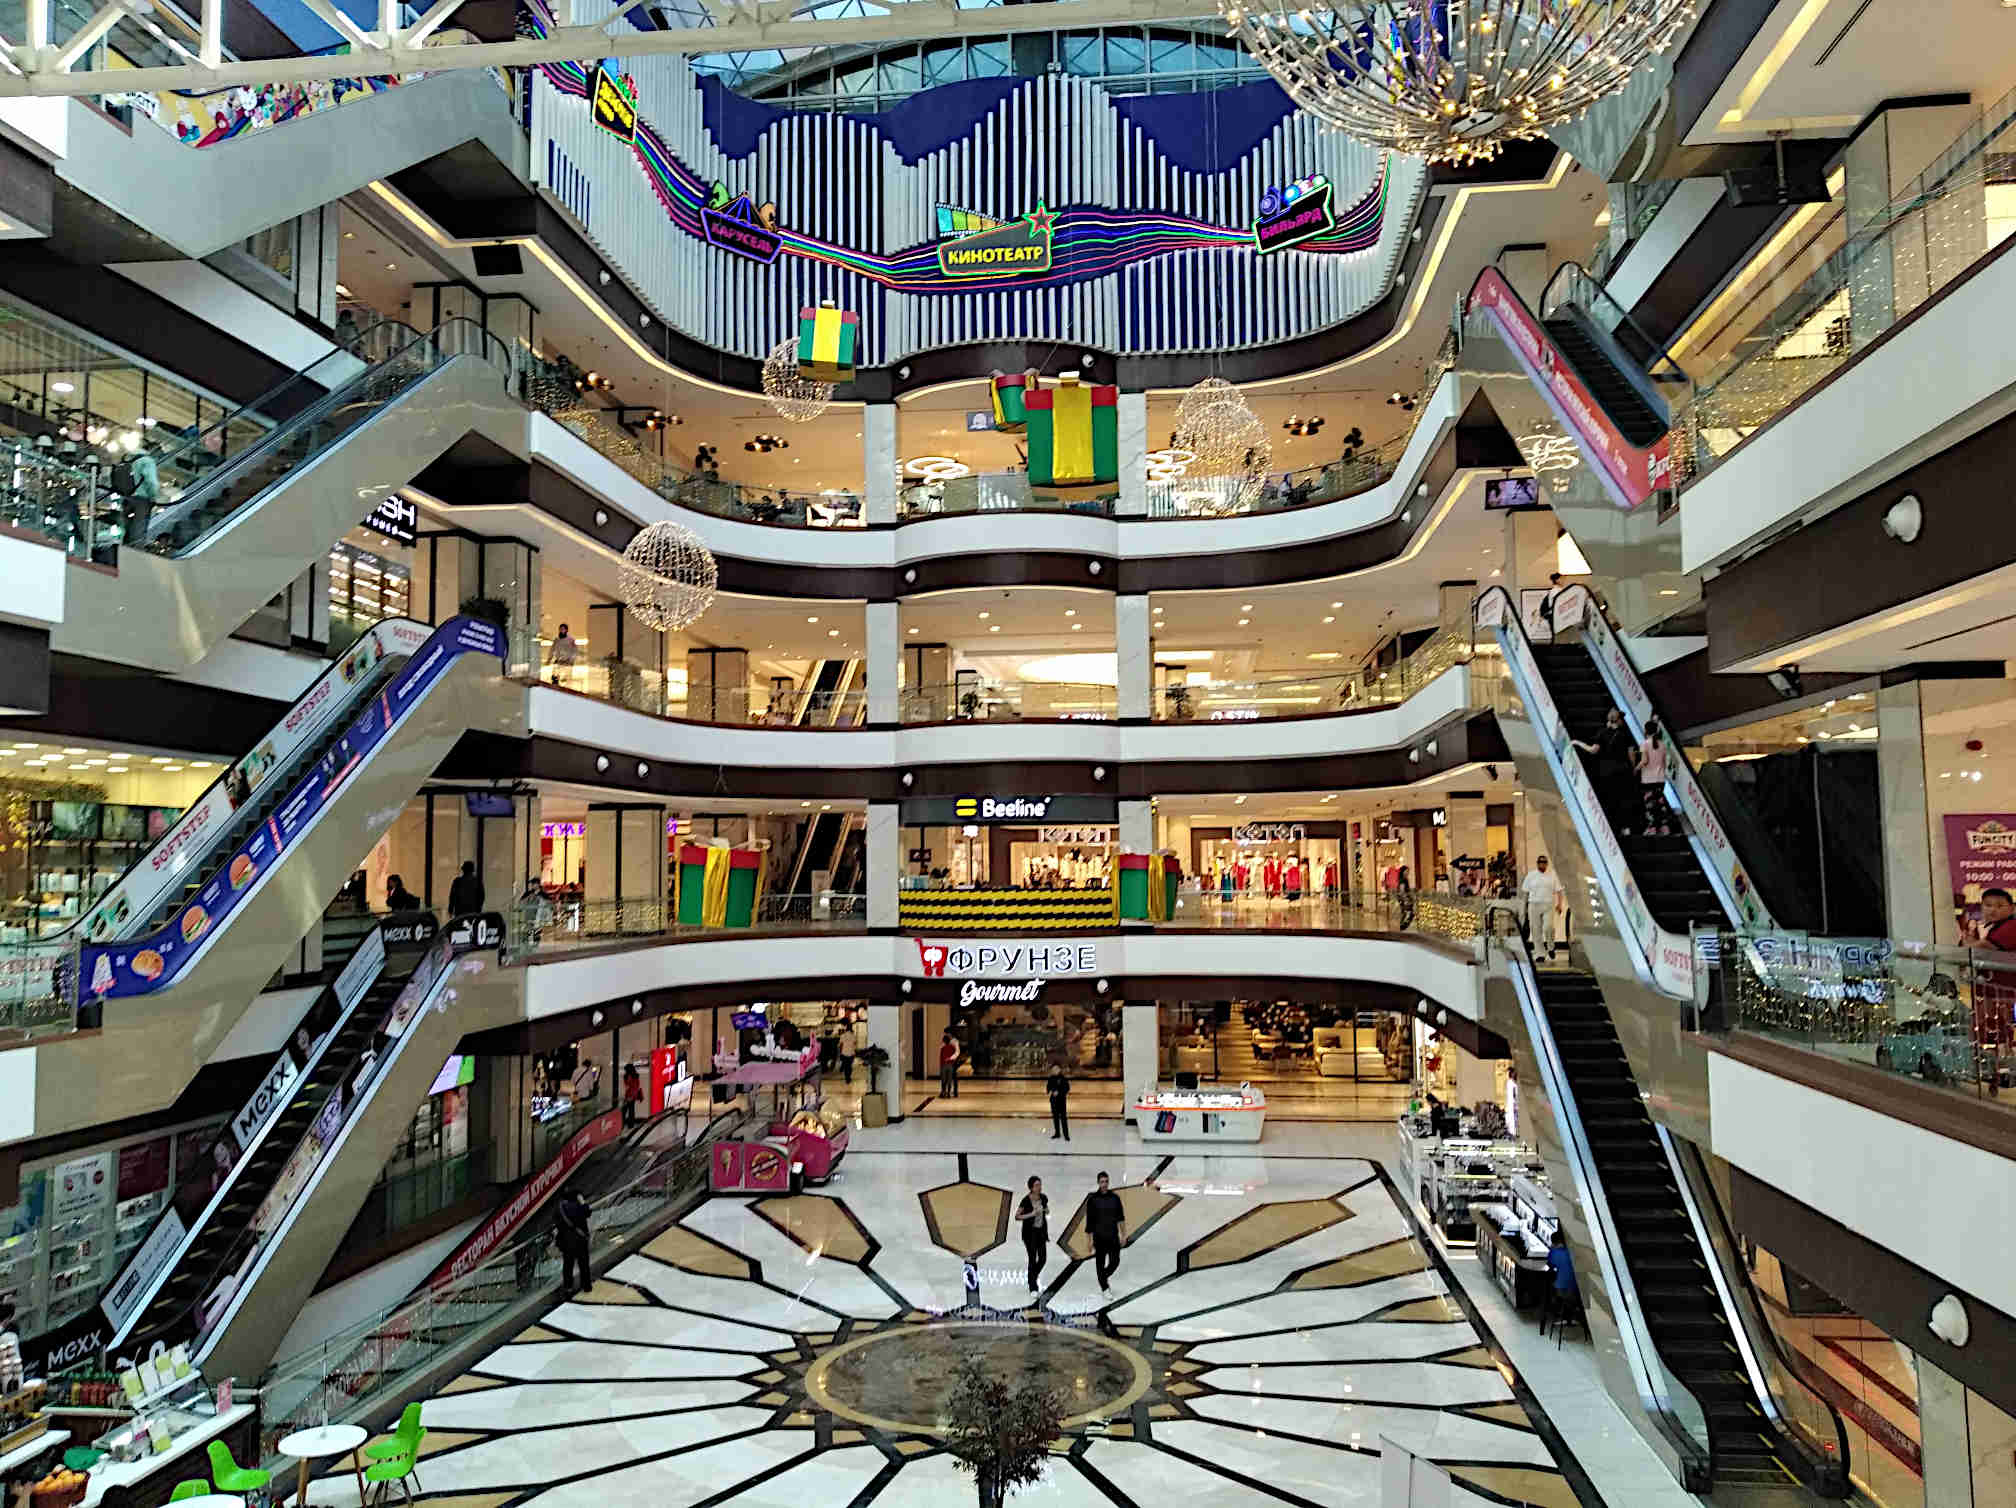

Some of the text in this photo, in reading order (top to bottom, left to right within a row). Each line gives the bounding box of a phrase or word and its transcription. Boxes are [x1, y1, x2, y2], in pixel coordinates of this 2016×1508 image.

[948, 246, 1044, 265] КИНОТЕАТР
[982, 798, 1046, 818] Beeline
[151, 804, 210, 872] SOFTSTEP
[949, 945, 1097, 974] ФРУНЗЕ
[960, 977, 1046, 1007] Gourmet
